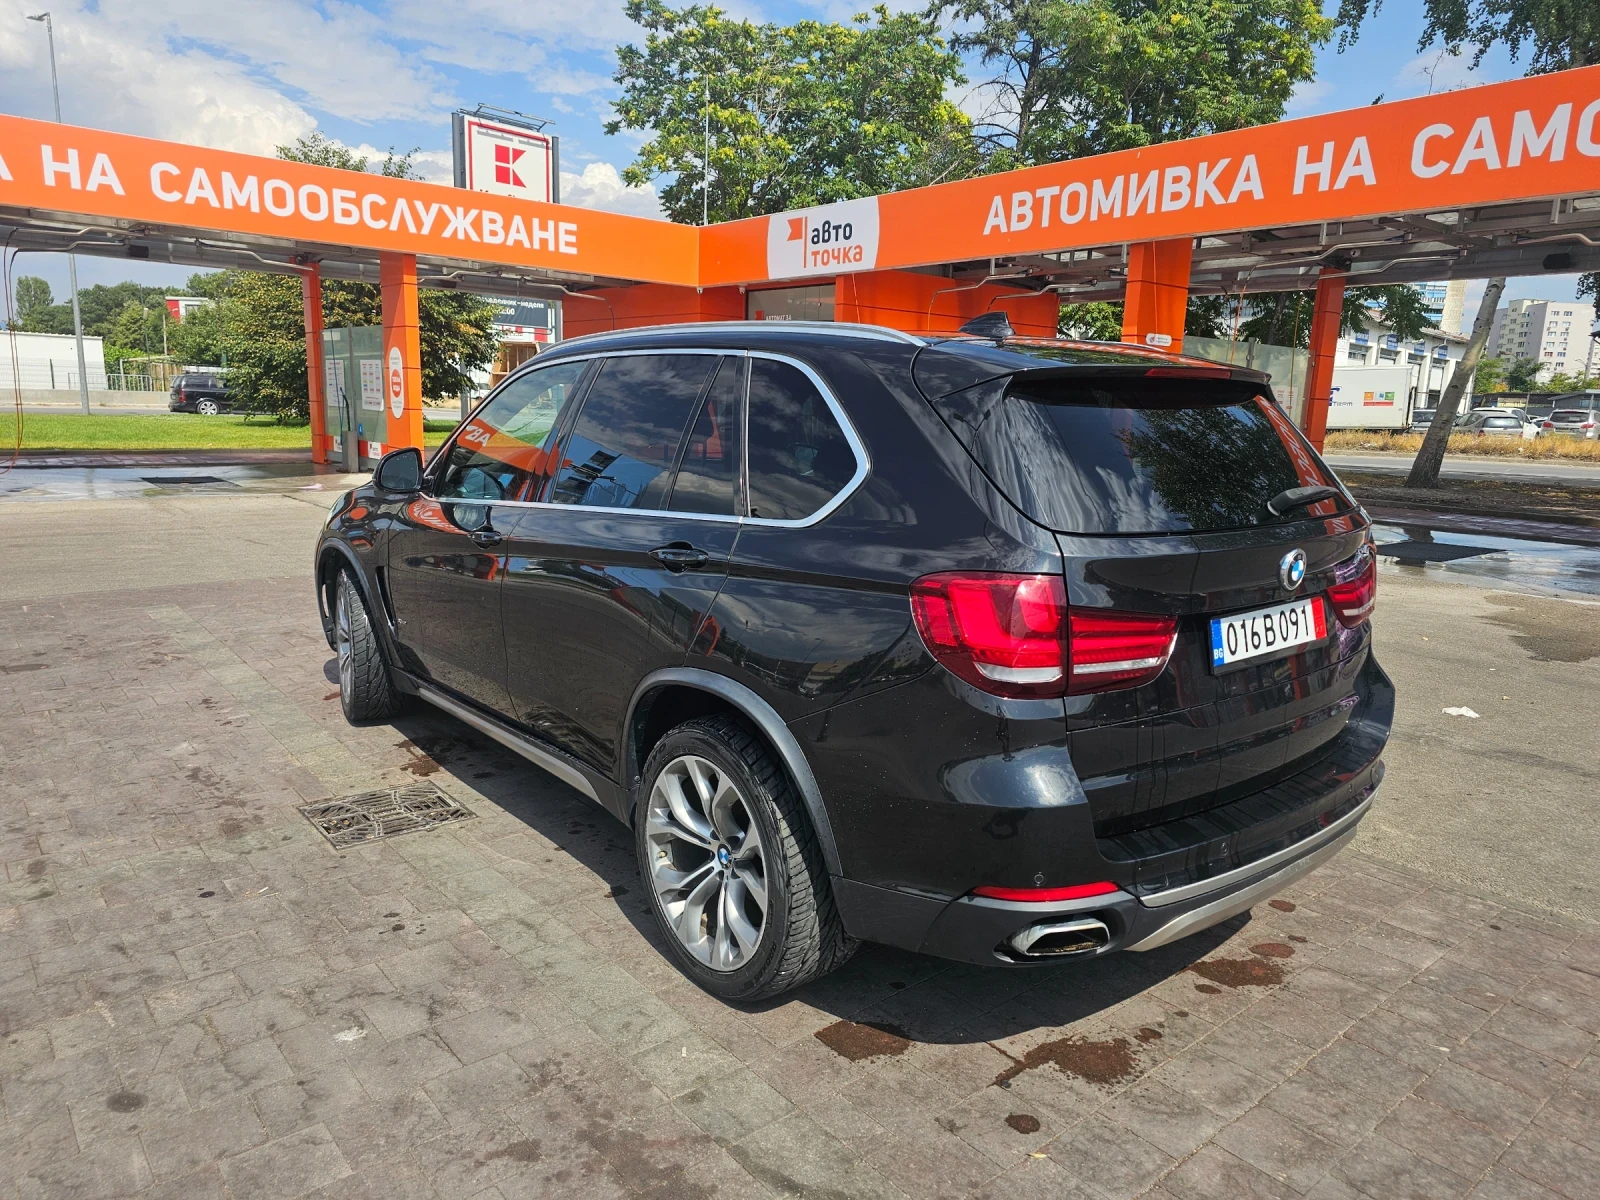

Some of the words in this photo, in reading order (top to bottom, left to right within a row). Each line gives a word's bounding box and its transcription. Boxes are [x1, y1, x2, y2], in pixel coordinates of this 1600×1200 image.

[41, 144, 125, 195] НА
[150, 162, 577, 254] САМООБСЛУЖВАНЕ
[984, 155, 1263, 234] АВТОМИВКА
[1293, 137, 1376, 194] НА
[811, 220, 853, 245] авто
[811, 244, 863, 267] точка
[1213, 648, 1224, 659] BG
[1227, 605, 1309, 656] 016B091
